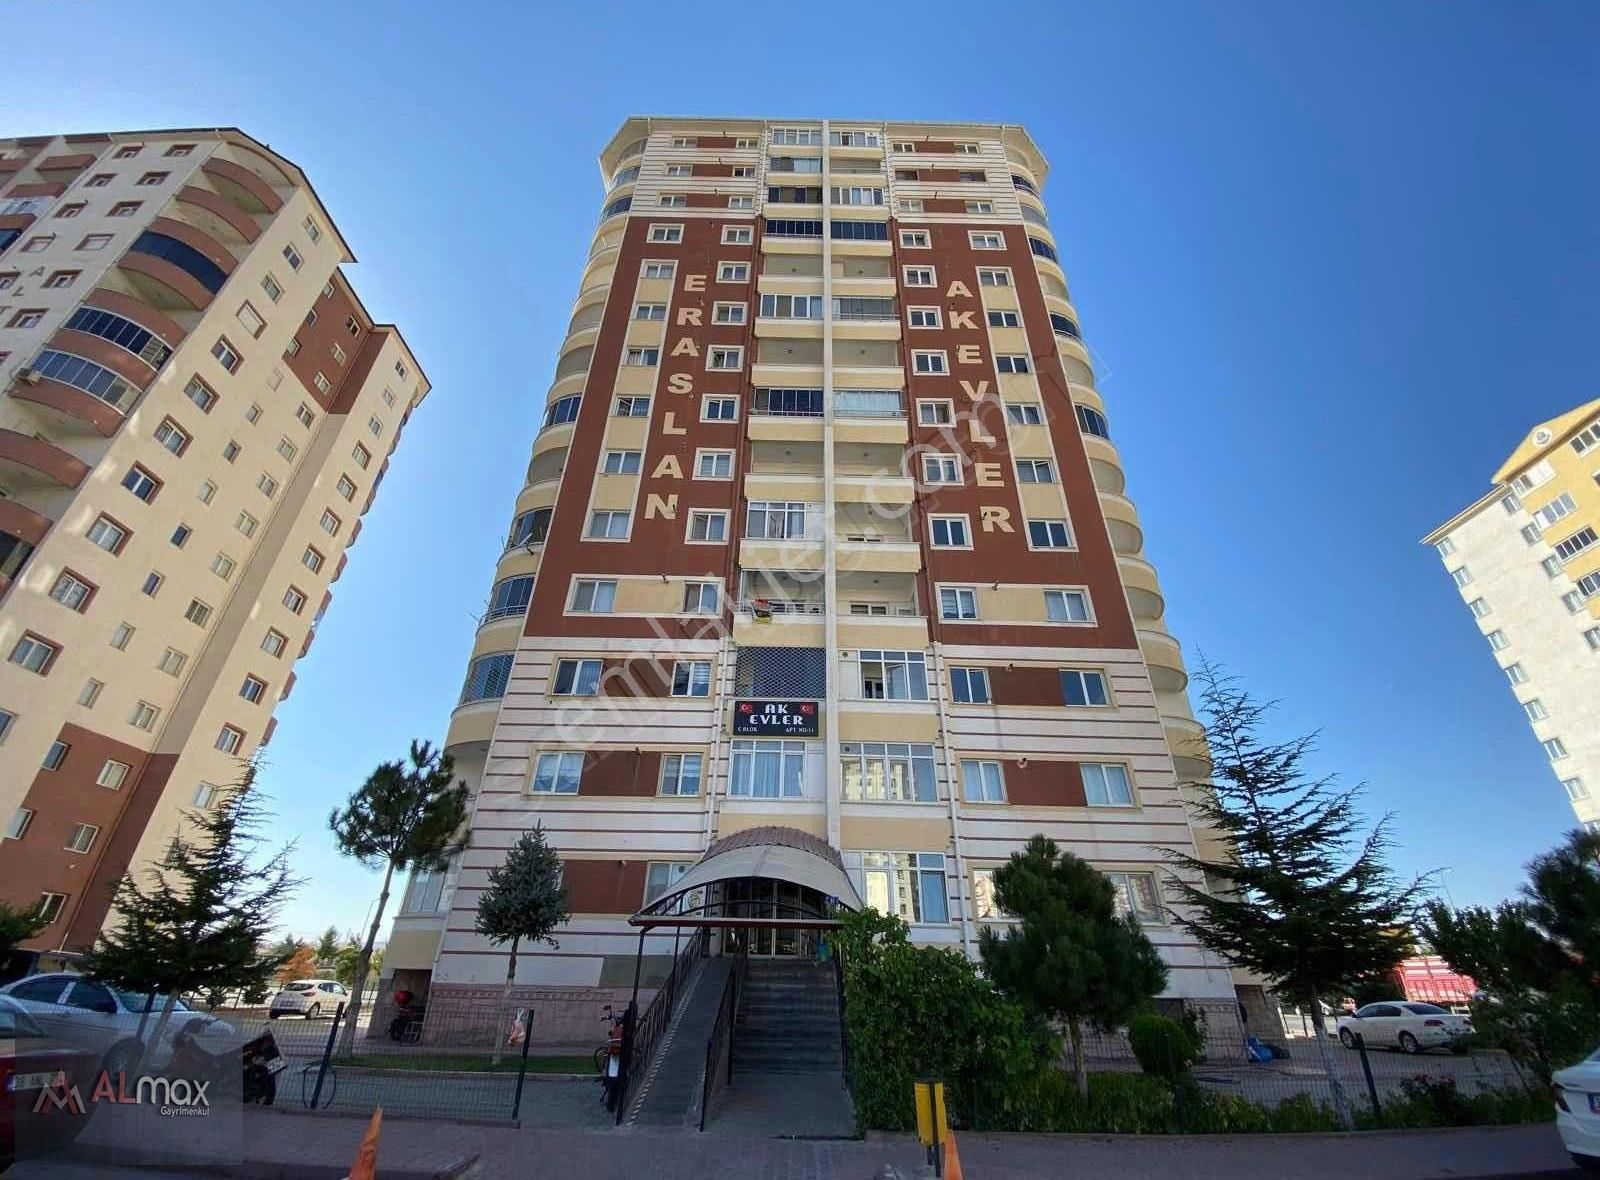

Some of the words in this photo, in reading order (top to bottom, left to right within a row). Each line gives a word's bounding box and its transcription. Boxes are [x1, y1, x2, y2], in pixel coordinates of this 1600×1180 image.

[644, 274, 707, 520] ERASLAN
[764, 703, 788, 714] AK
[749, 714, 804, 725] EVLER
